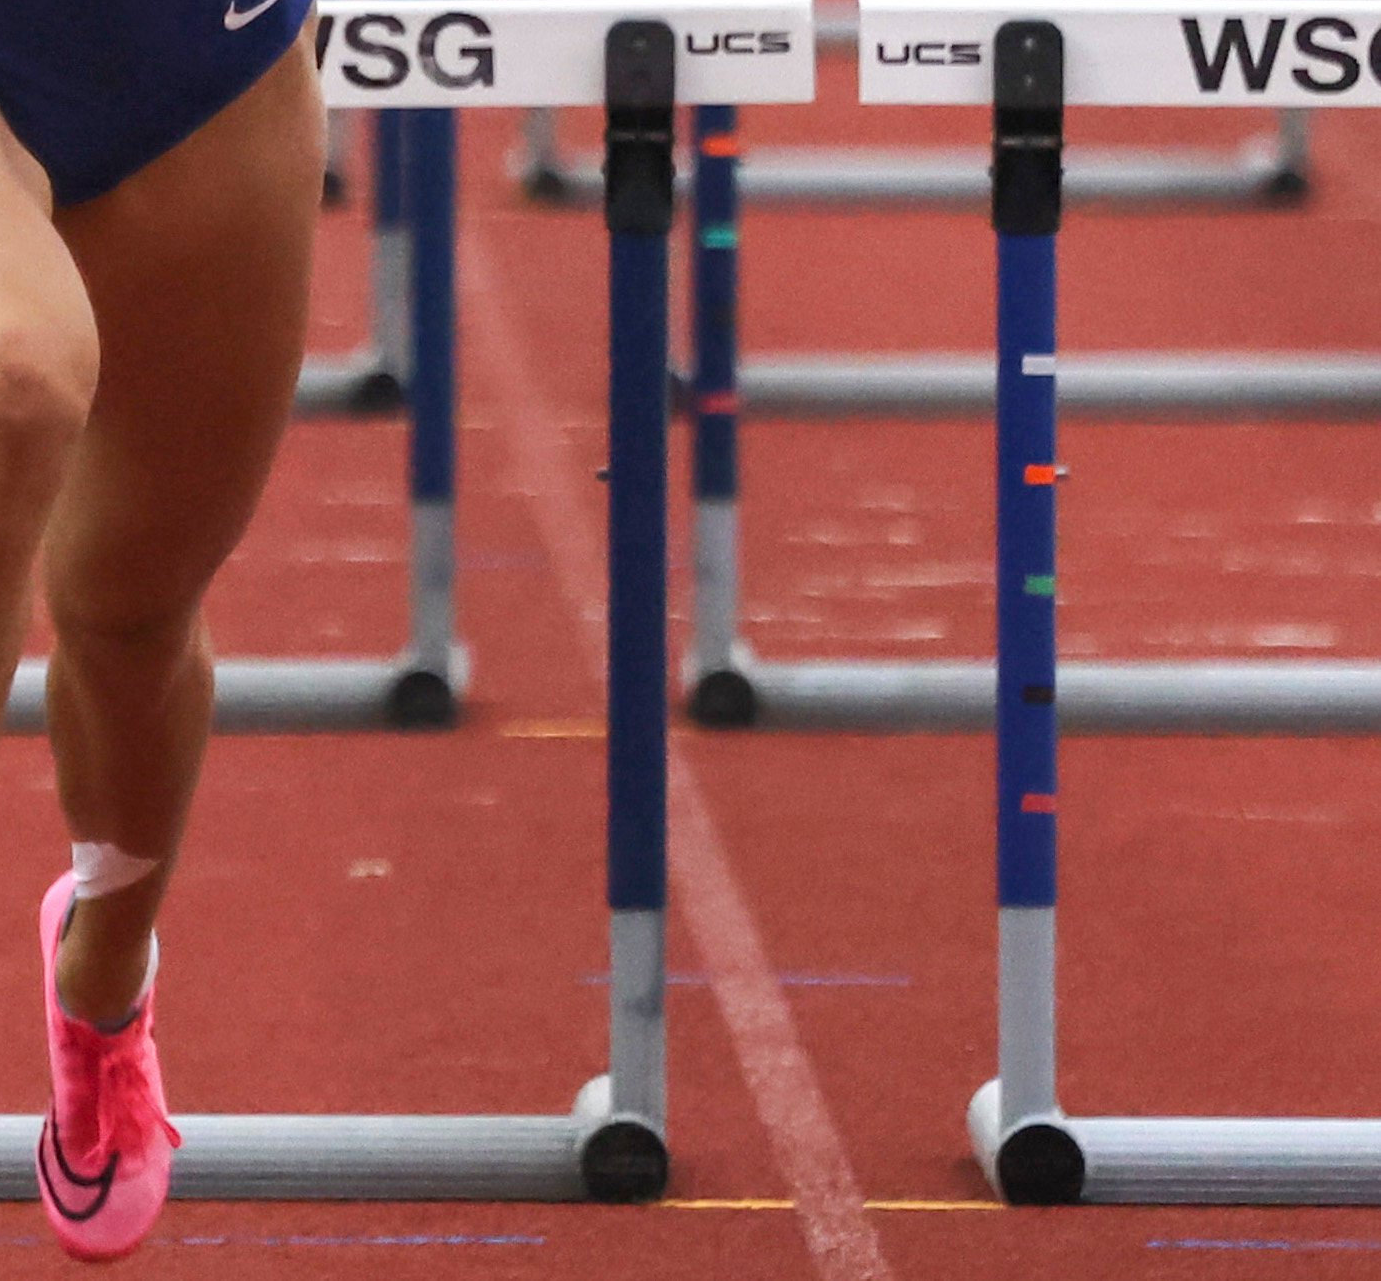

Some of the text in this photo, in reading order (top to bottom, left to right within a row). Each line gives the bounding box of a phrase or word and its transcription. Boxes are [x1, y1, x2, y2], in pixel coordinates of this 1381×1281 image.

[316, 13, 494, 89] SG
[686, 32, 790, 54] UCS
[877, 43, 981, 65] UCS
[1180, 16, 1381, 93] WS
